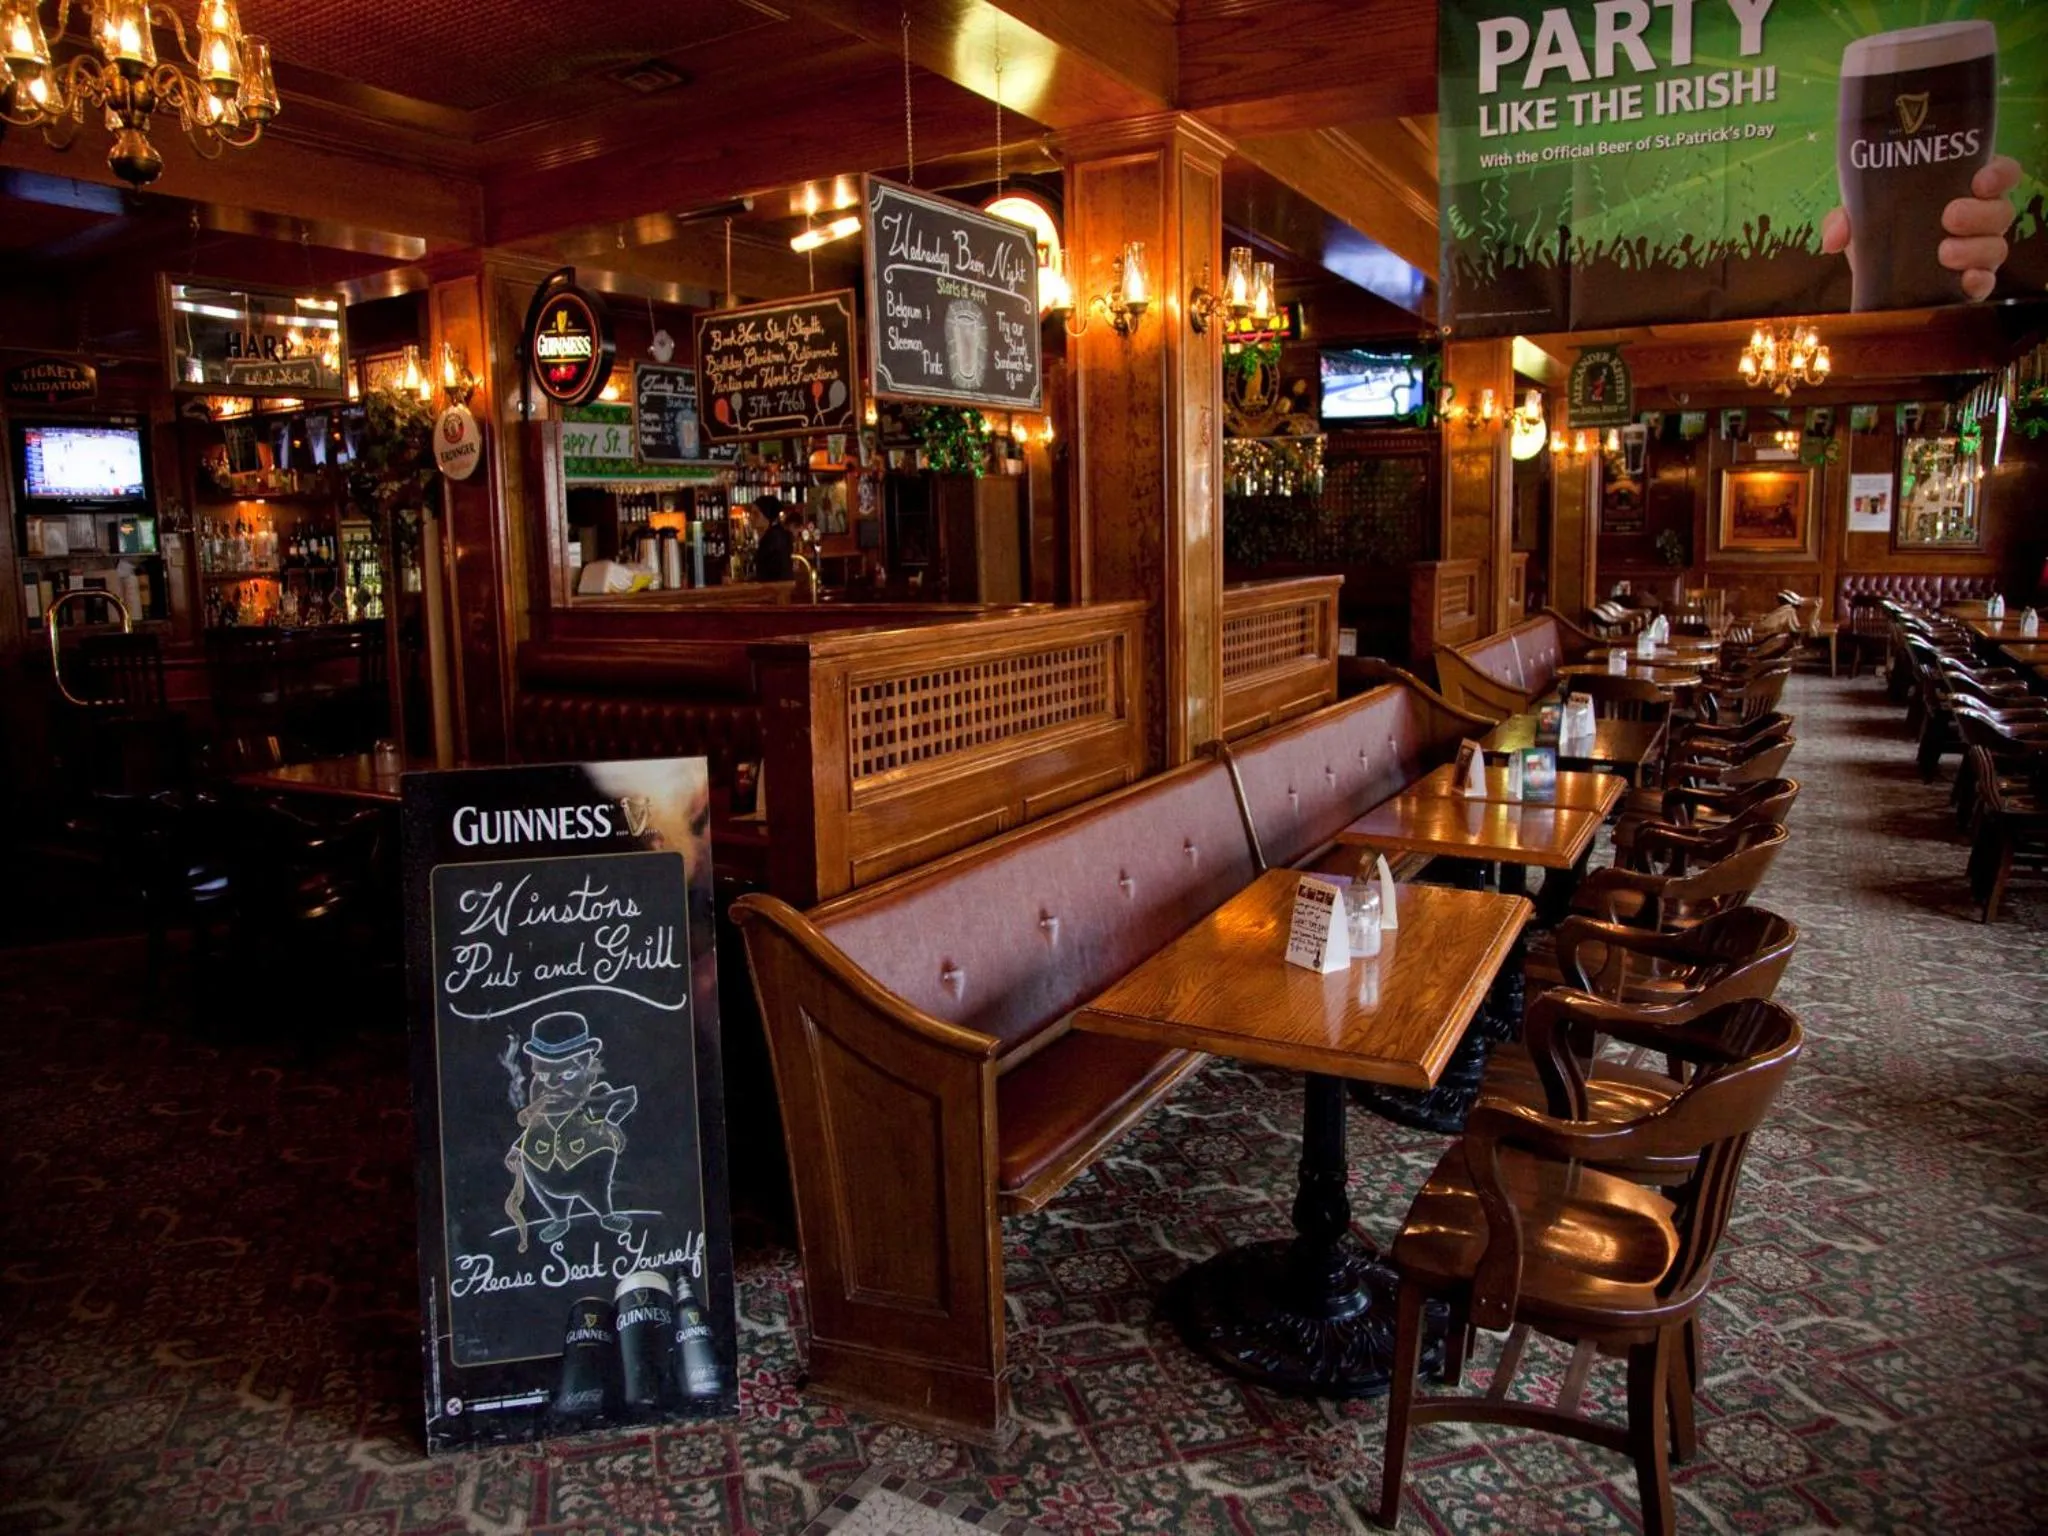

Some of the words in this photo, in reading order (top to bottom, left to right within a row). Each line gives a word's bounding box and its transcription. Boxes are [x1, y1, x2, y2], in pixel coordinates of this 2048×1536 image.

[1477, 0, 1773, 95] PARTY
[1478, 98, 1557, 138] LIKE
[1567, 84, 1643, 127] THE
[1655, 65, 1777, 116] IRISH!
[1480, 153, 1512, 168] With
[1516, 150, 1539, 166] the
[1542, 143, 1595, 161] Official
[1598, 141, 1634, 156] Beer
[1635, 135, 1652, 151] of
[1744, 123, 1775, 140] Day
[1850, 128, 1981, 169] GUINNESS
[987, 241, 1027, 296] Night
[537, 333, 592, 357] GUINNESS
[11, 380, 91, 392] VALIDATION
[21, 363, 78, 380] TICKET
[563, 431, 599, 456] appy
[601, 426, 622, 454] St.
[452, 803, 612, 847] GUINNESS
[459, 873, 643, 936] Winstons
[444, 941, 523, 994] Pub
[534, 941, 588, 980] and
[593, 923, 682, 984] Grill
[450, 1253, 537, 1298] Please
[541, 1240, 609, 1287] Seat
[612, 1229, 706, 1280] Yourself
[615, 1306, 673, 1332] GUINNESS
